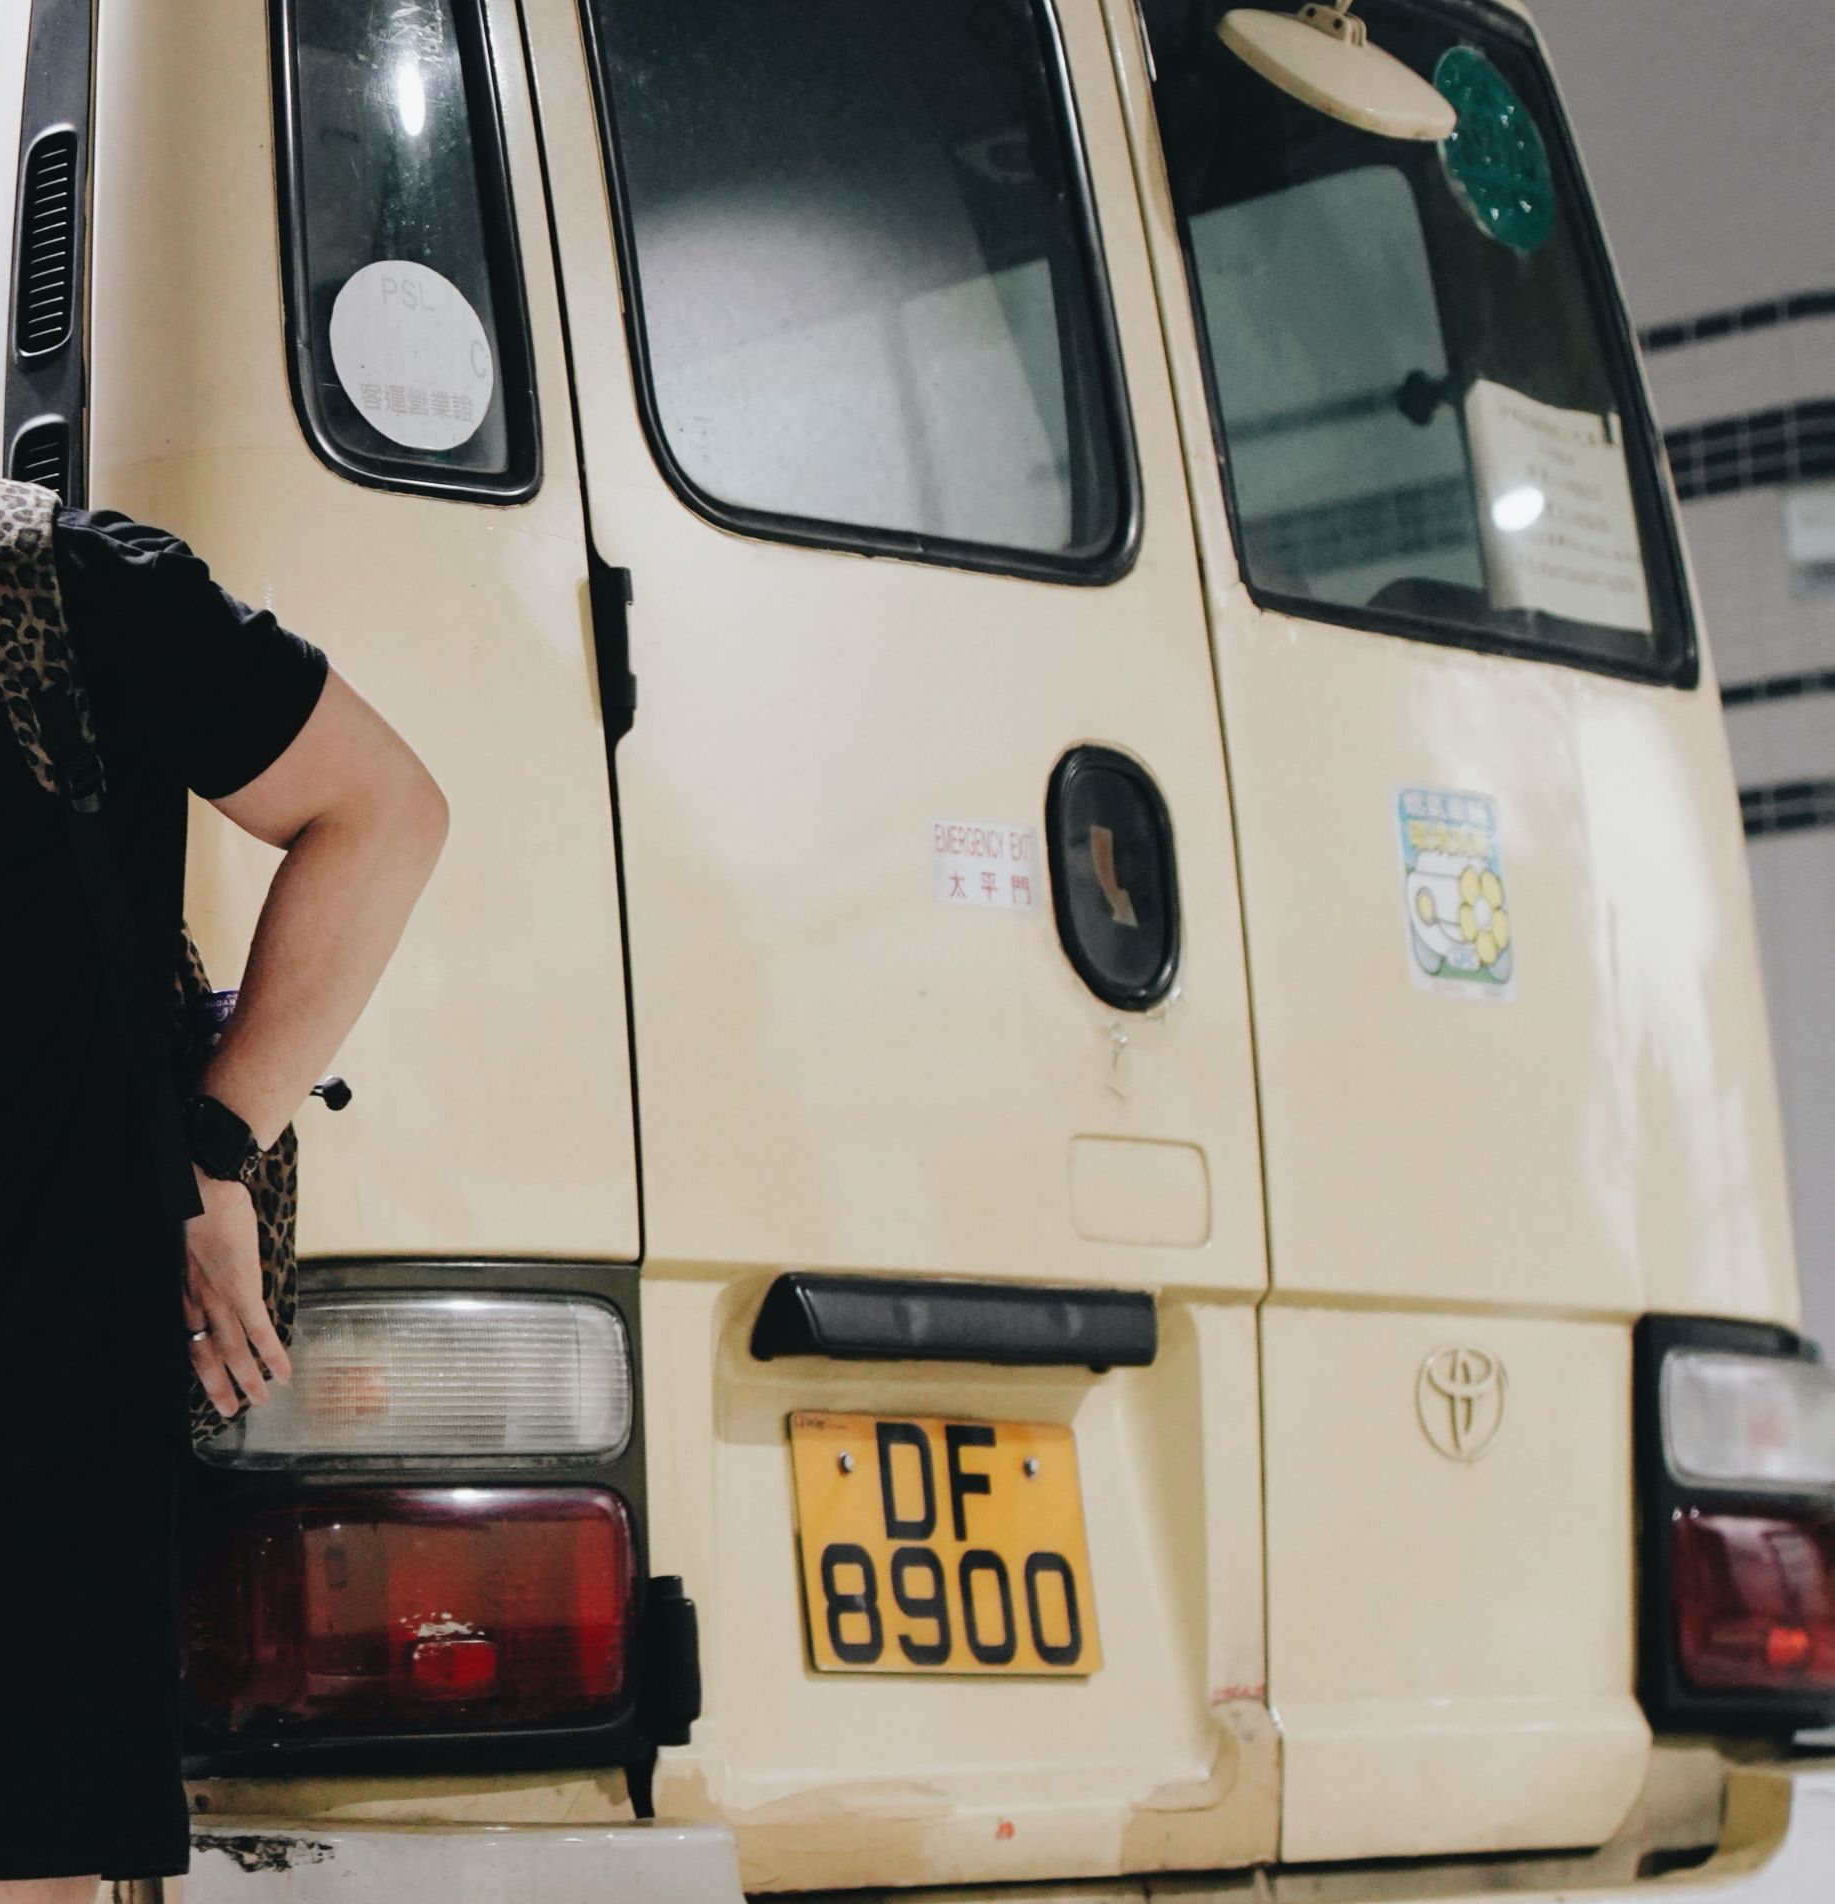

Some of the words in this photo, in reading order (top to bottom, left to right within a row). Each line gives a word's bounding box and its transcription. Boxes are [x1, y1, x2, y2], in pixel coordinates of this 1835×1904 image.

[380, 277, 435, 312] PSL
[934, 823, 1004, 859] EMERGENCY
[1009, 832, 1033, 861] EXIT
[948, 869, 1031, 906] 太平門
[875, 1422, 997, 1542] DF
[820, 1543, 1084, 1666] 8900
